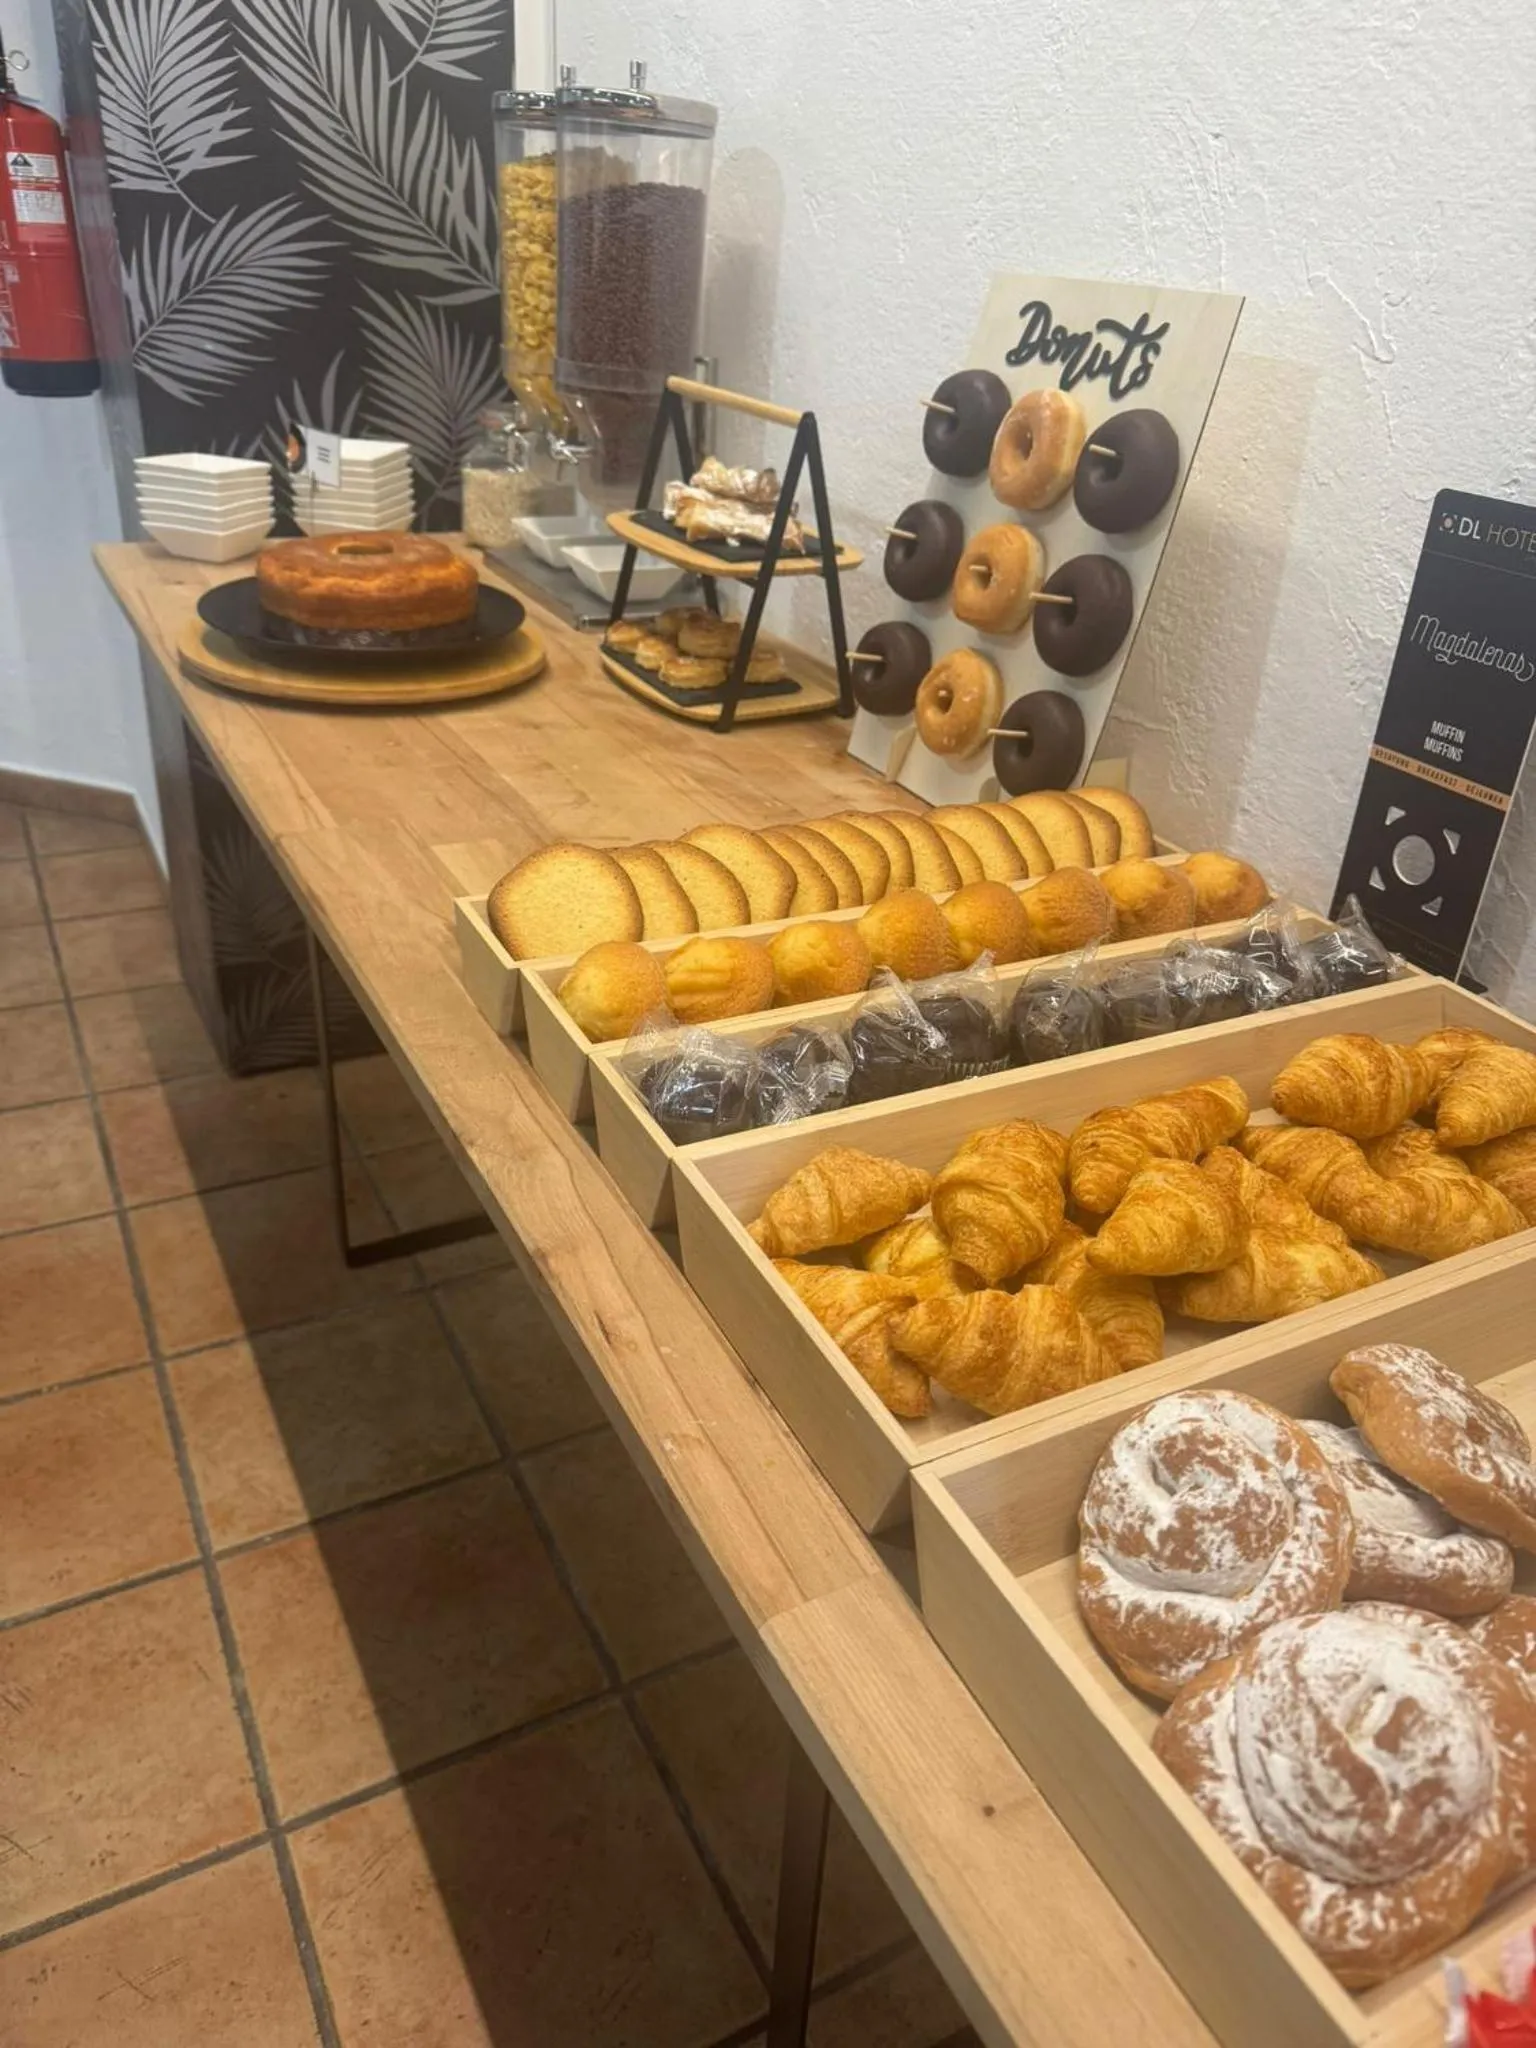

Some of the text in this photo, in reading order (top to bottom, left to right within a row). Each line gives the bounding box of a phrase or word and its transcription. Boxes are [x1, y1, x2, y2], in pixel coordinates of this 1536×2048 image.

[1005, 300, 1170, 401] Donuts
[1458, 516, 1480, 539] DL
[1409, 613, 1535, 682] Magdalenas
[1430, 720, 1466, 744] MUFFIN
[1423, 736, 1464, 762] MUFFINS
